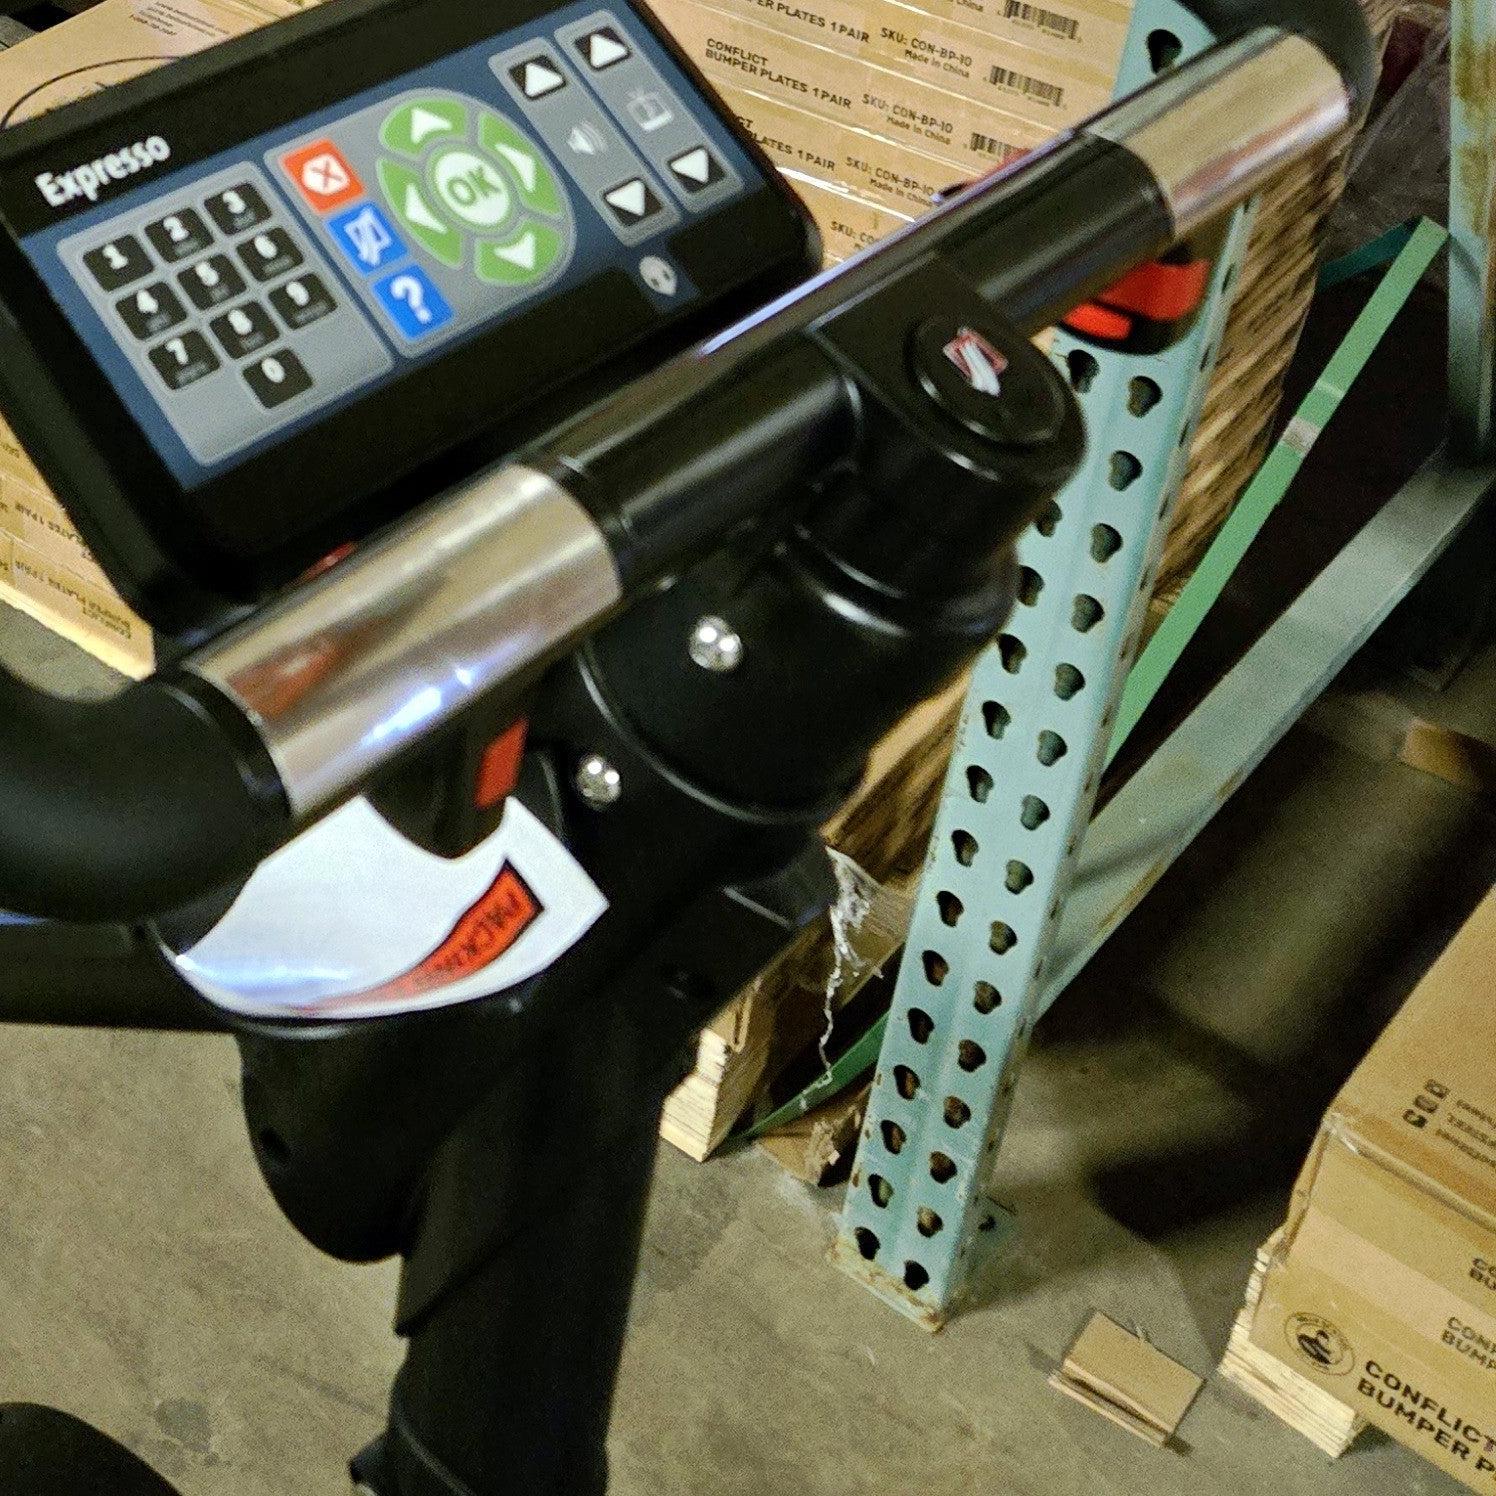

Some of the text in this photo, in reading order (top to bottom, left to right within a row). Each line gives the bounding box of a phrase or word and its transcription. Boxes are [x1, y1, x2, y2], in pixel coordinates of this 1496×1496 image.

[776, 2, 826, 28] PLATES
[830, 21, 871, 44] 1PAIR
[706, 38, 769, 67] CONFLICT
[880, 27, 973, 68] SKU: CON-BP-10
[705, 48, 853, 109] BUMPER PLATES 1PAIR
[862, 93, 954, 134] SKU: CON-BP-10
[34, 135, 171, 207] Expresso
[798, 149, 836, 171] 1PAIR
[846, 156, 872, 174] SKU:
[445, 166, 501, 208] OK
[102, 190, 246, 270] 1 2 3
[830, 221, 855, 239] SKU:
[136, 289, 159, 314] 4
[165, 337, 189, 365] 7
[1357, 1377, 1470, 1461] BUMPER
[1365, 1360, 1496, 1452] CONFLICT
